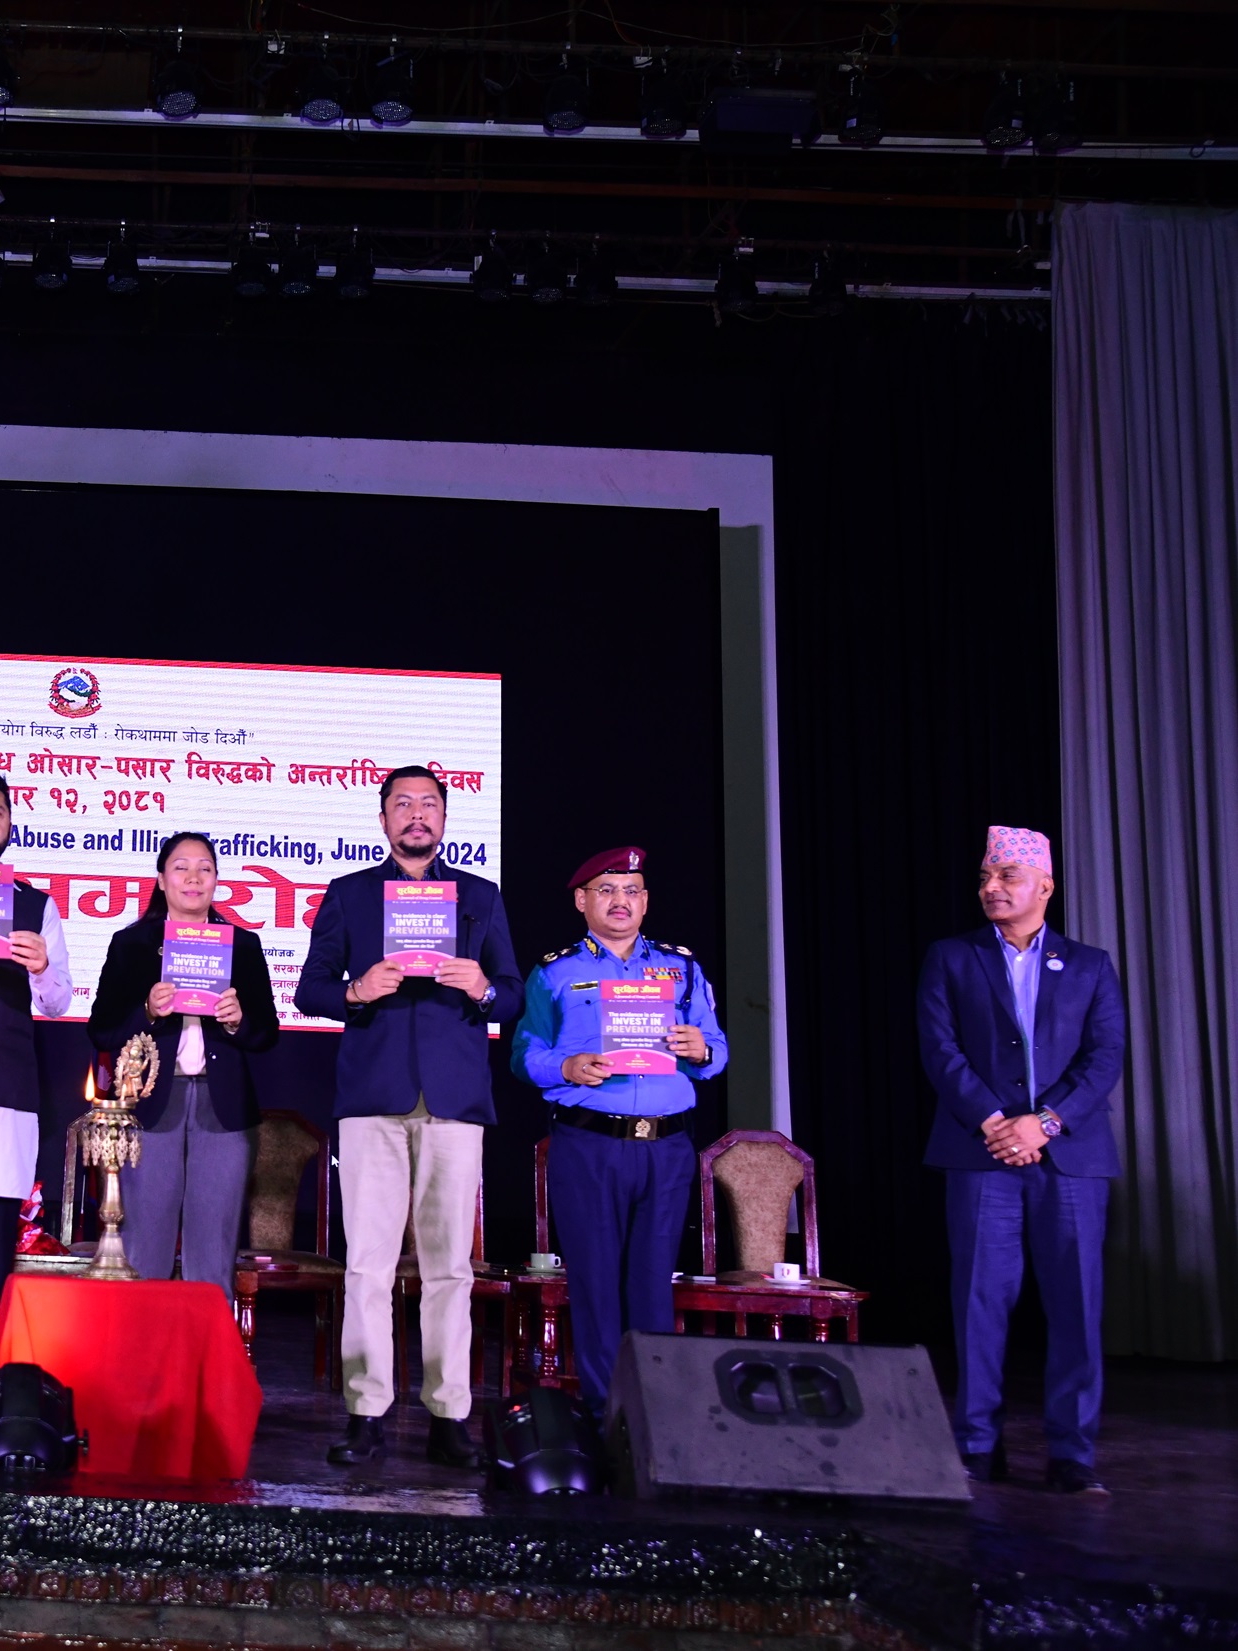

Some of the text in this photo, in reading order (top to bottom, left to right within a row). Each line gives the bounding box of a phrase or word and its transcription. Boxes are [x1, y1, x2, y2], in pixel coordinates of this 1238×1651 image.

[30, 721, 65, 739] विरुद्ध
[114, 723, 177, 742] रोकथाममा
[183, 727, 210, 744] जोड
[185, 751, 275, 785] विरुद्धको
[103, 789, 166, 815] २०८१
[9, 824, 76, 850] Abuse
[83, 828, 123, 851] and
[331, 837, 384, 862] June
[167, 965, 224, 976] PREVENTION
[174, 958, 207, 967] INVEST
